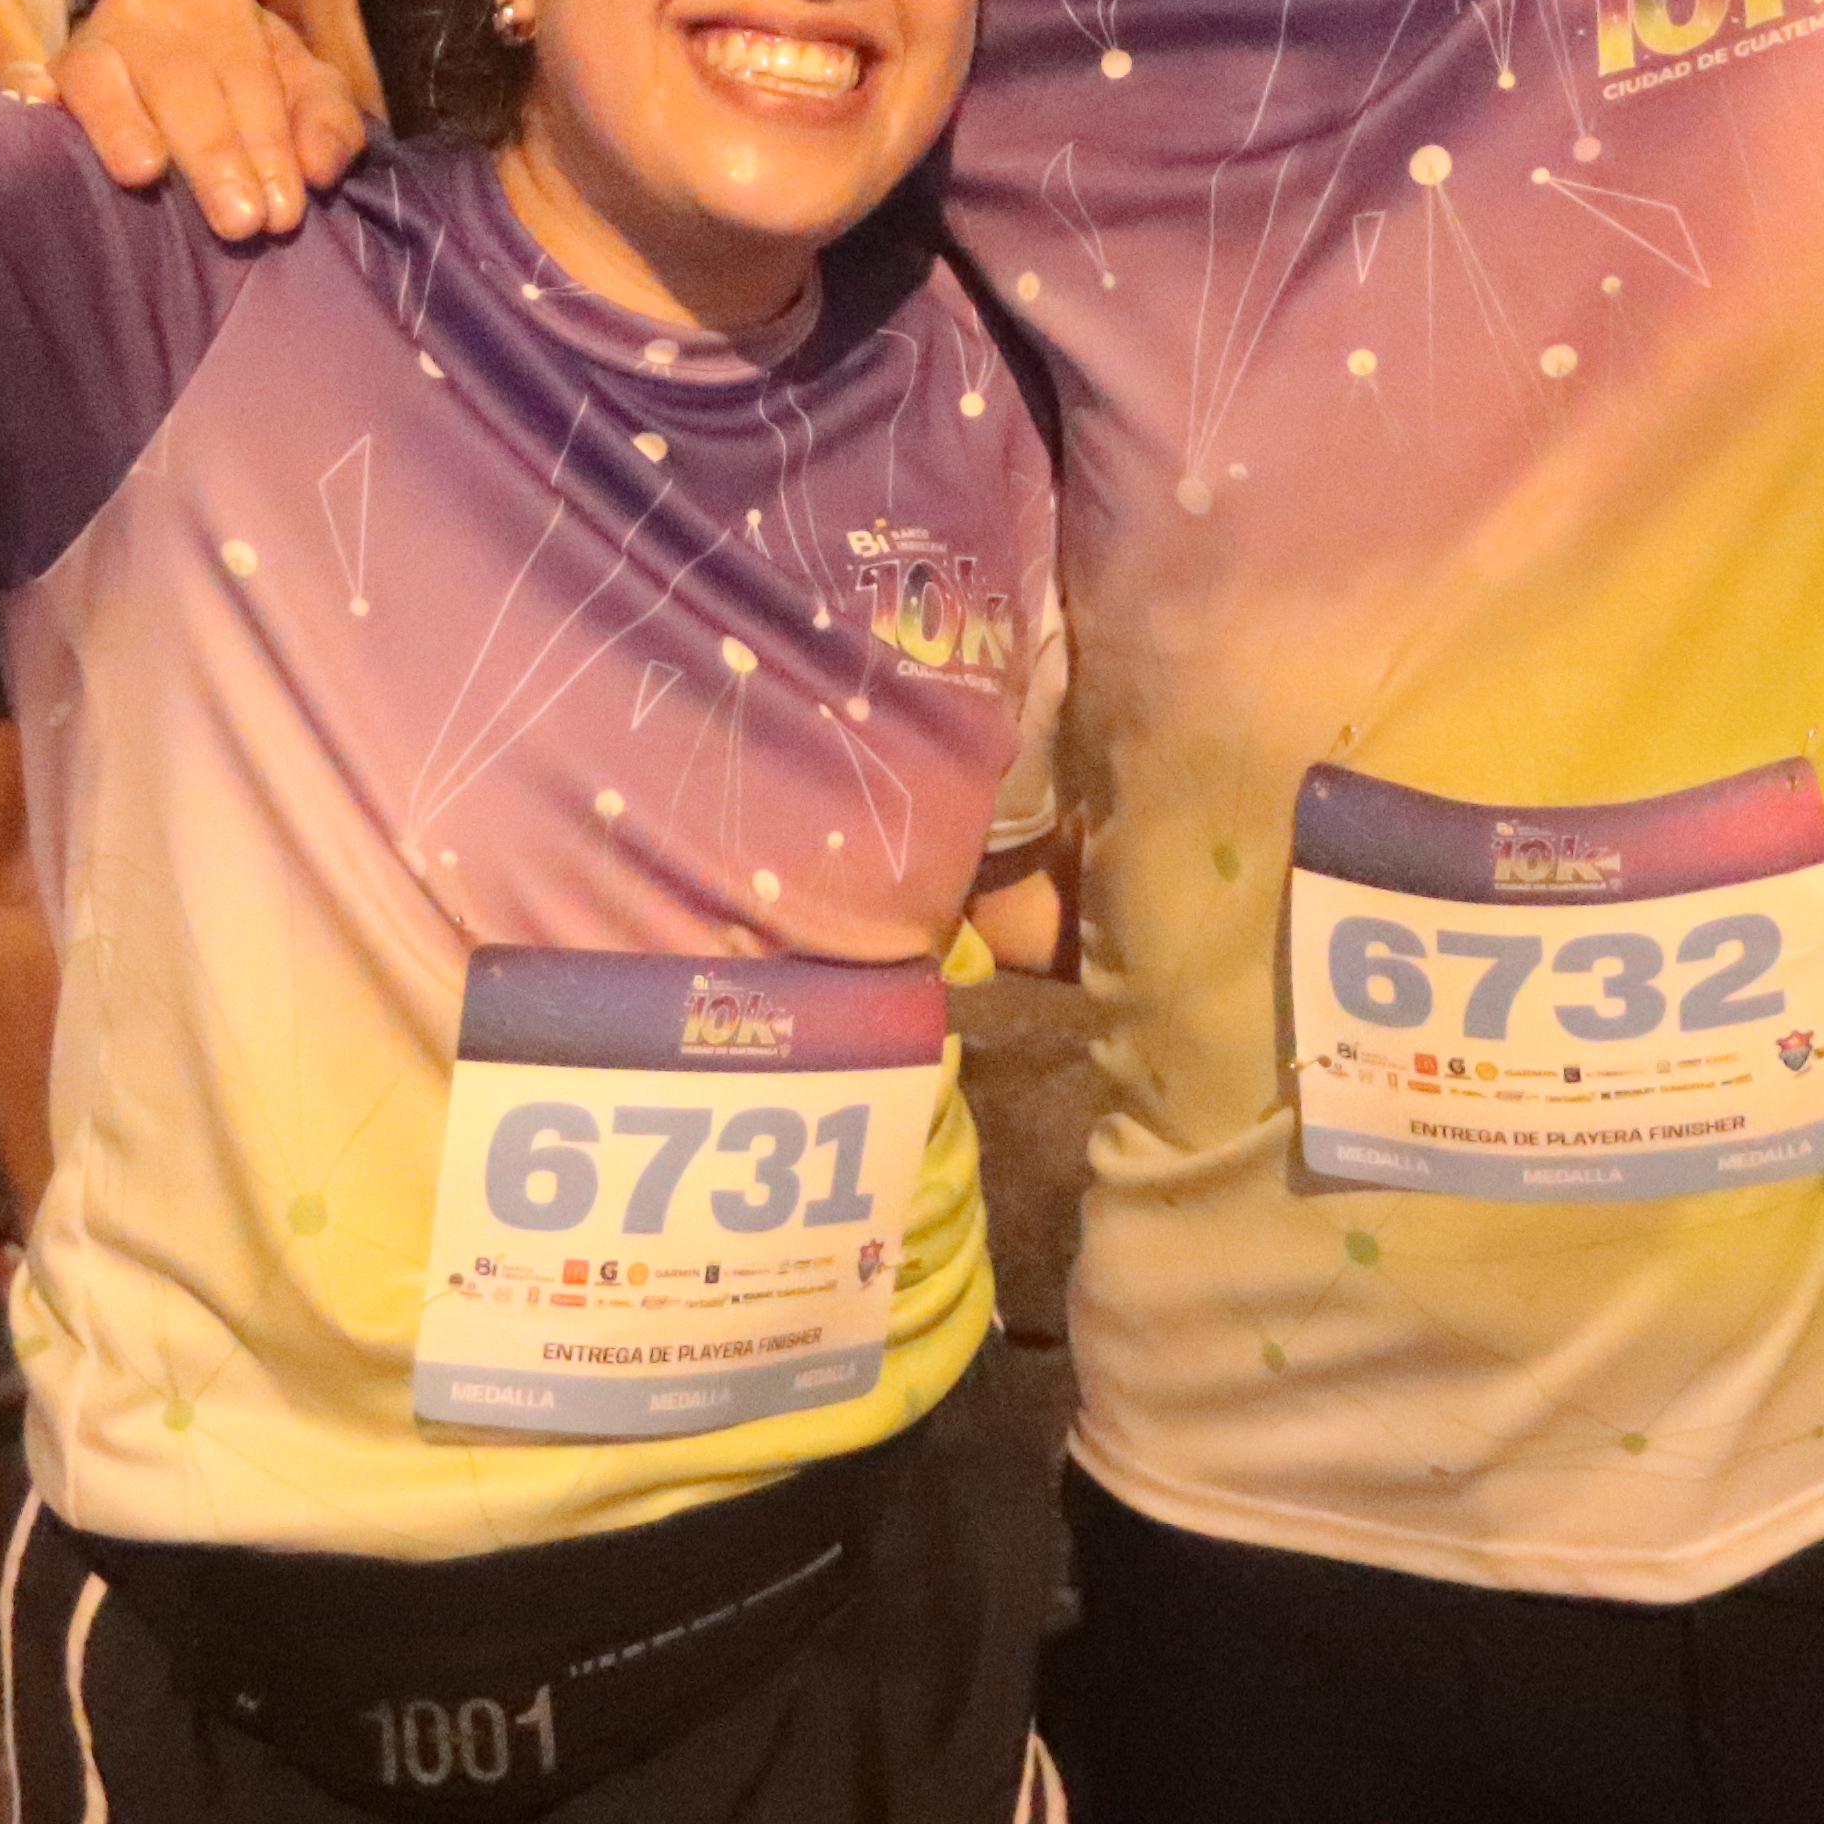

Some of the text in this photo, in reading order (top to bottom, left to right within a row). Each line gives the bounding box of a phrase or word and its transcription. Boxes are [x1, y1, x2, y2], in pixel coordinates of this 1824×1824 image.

[1602, 60, 1692, 101] CIUDAD
[1697, 47, 1729, 71] DE
[847, 518, 891, 557] Bi
[1329, 913, 1786, 1041] 6732
[1409, 1115, 1747, 1146] ENTREGA DE PLAYERA FINISHER
[484, 1101, 875, 1235] 6731
[1336, 1139, 1813, 1185] MEDALLA MEDALLA MEDALLA
[542, 1326, 824, 1365] ENTREGA DE PLAYERA FINISHER
[449, 1361, 858, 1415] MEDALLA MEDALLA MEDALLA
[360, 1684, 557, 1785] 1001
